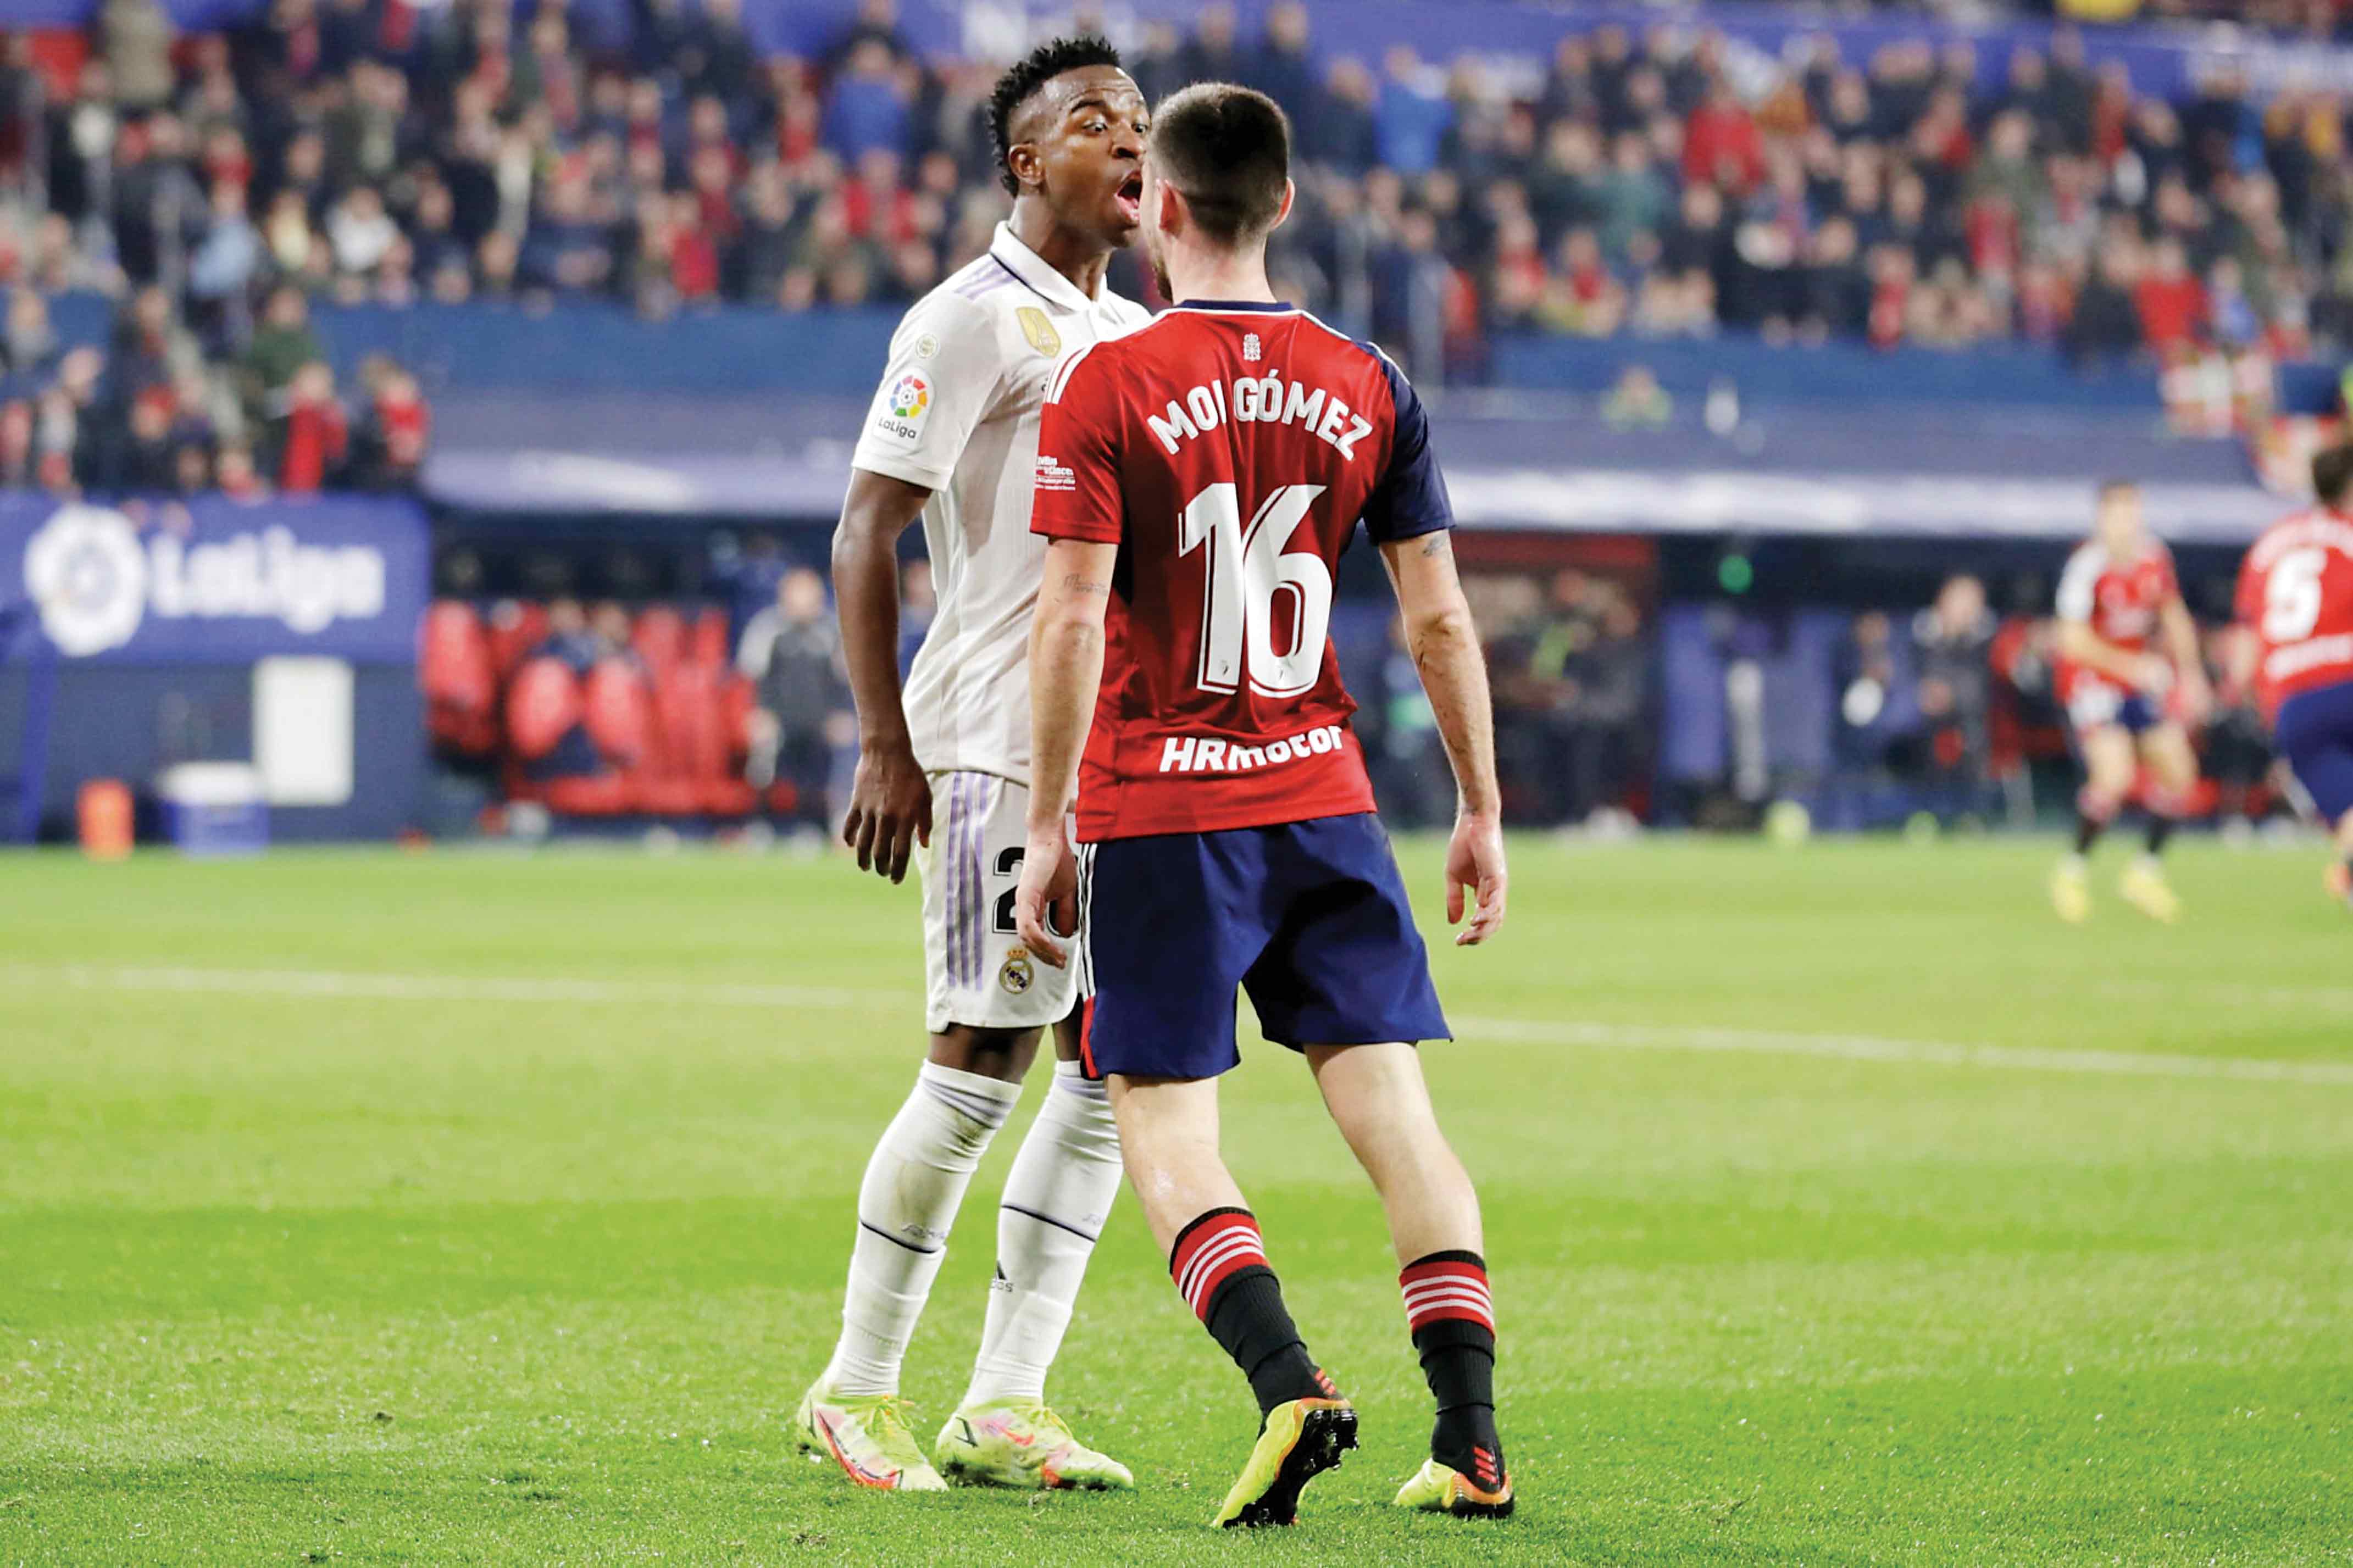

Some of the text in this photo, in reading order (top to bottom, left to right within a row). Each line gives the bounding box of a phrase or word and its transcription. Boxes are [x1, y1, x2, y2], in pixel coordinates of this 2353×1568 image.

[878, 416, 917, 439] LaLiga
[1147, 369, 1373, 461] MOI GÓMEZ
[1178, 483, 1333, 698] 16
